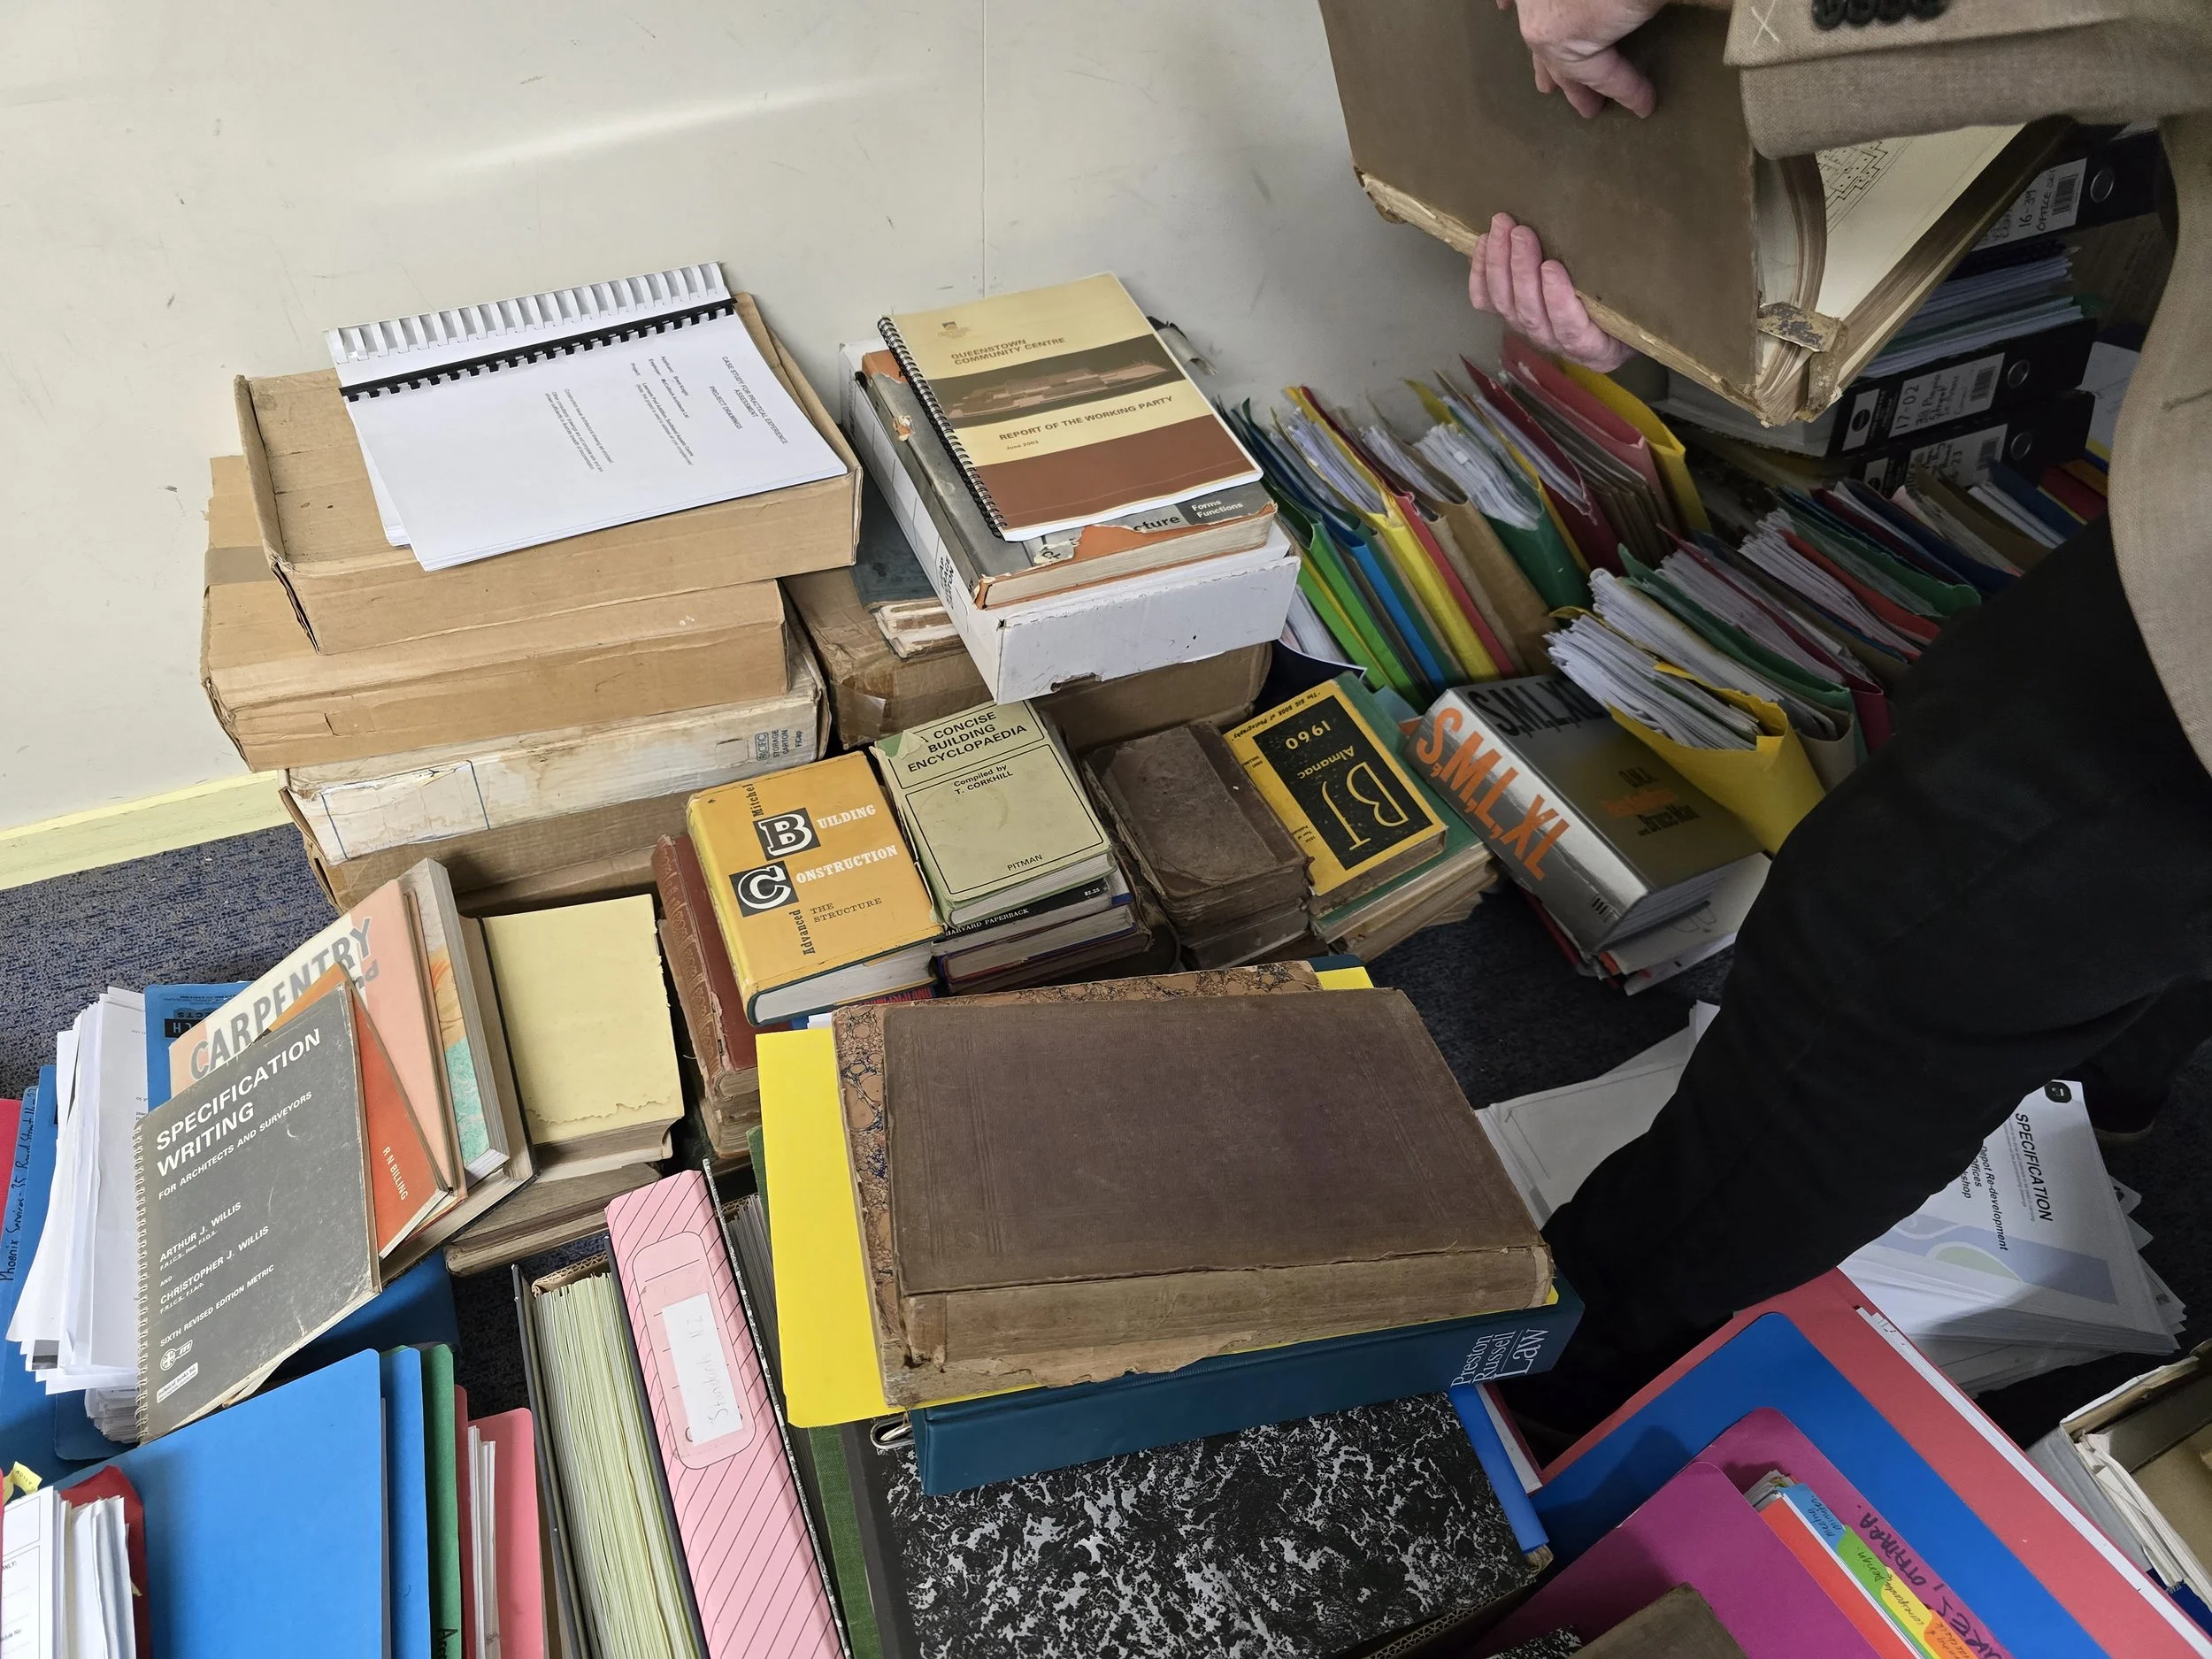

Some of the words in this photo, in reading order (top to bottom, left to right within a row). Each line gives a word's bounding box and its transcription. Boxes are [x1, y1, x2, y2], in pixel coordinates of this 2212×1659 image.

[951, 339, 1026, 359] QUEENSTOWN
[955, 347, 1020, 365] COMMUNITY
[1025, 337, 1065, 350] CENTRE
[709, 386, 726, 407] PROJECT
[722, 405, 743, 430] DRAWINGS
[722, 356, 733, 371] CASE
[730, 369, 744, 386] STUDY
[741, 383, 751, 396] FOR
[747, 394, 768, 419] PRACTICAL
[764, 418, 789, 445] EXPERIENCE
[733, 388, 758, 418] ASSESSMENT
[999, 426, 1041, 441] REPORT
[1061, 417, 1083, 427] THE
[1084, 405, 1136, 422] WORKING
[1138, 396, 1173, 410] PARTY
[1192, 499, 1222, 512] Forms
[1196, 502, 1243, 518] Functions
[928, 724, 995, 753] BUILDING
[933, 711, 997, 739] CONCISE
[1286, 720, 1331, 749] 1960
[757, 733, 769, 759] PACIFIC
[908, 725, 1027, 772] ENCYCLOPAEDIA
[1297, 746, 1356, 780] Almanac
[954, 769, 994, 787] Compiled
[996, 764, 1007, 774] by
[967, 772, 1014, 791] CORKHILL
[1322, 762, 1409, 850] BJ
[1417, 708, 1570, 881] S,M,L,XL
[1007, 854, 1043, 871] PITMAN
[810, 902, 834, 915] THE
[1084, 887, 1101, 897] $2.25
[813, 897, 882, 923] STRUCTURE
[945, 920, 982, 937] HARVARD
[985, 908, 1030, 926] PAPERBACK
[789, 910, 815, 956] Advanced
[157, 1028, 320, 1151] SPECIFICATION
[157, 1102, 254, 1177] WRITING
[158, 1184, 176, 1200] FOR
[180, 1144, 234, 1186] ARCHITECTS
[237, 1130, 257, 1148] AND
[259, 1092, 311, 1132] SURVEYORS
[383, 1146, 391, 1156] R
[387, 1154, 396, 1165] N
[2016, 1112, 2054, 1221] SPECIFICATION
[390, 1164, 408, 1201] BILLING
[1985, 1171, 2008, 1251] Re-development
[160, 1233, 196, 1263] ARTHUR
[200, 1226, 208, 1236] J.
[211, 1202, 242, 1226] WILLIS
[160, 1257, 223, 1305] CHRISTOPHER
[227, 1250, 235, 1260] J.
[238, 1225, 269, 1251] WILLIS
[160, 1276, 173, 1286] AND
[160, 1327, 181, 1347] SIXTH
[183, 1307, 213, 1332] REVISED
[216, 1285, 244, 1310] EDITION
[247, 1264, 274, 1288] METRIC
[1450, 1334, 1494, 1387] Preston
[1471, 1331, 1517, 1383] Russell
[1493, 1329, 1549, 1379] Law
